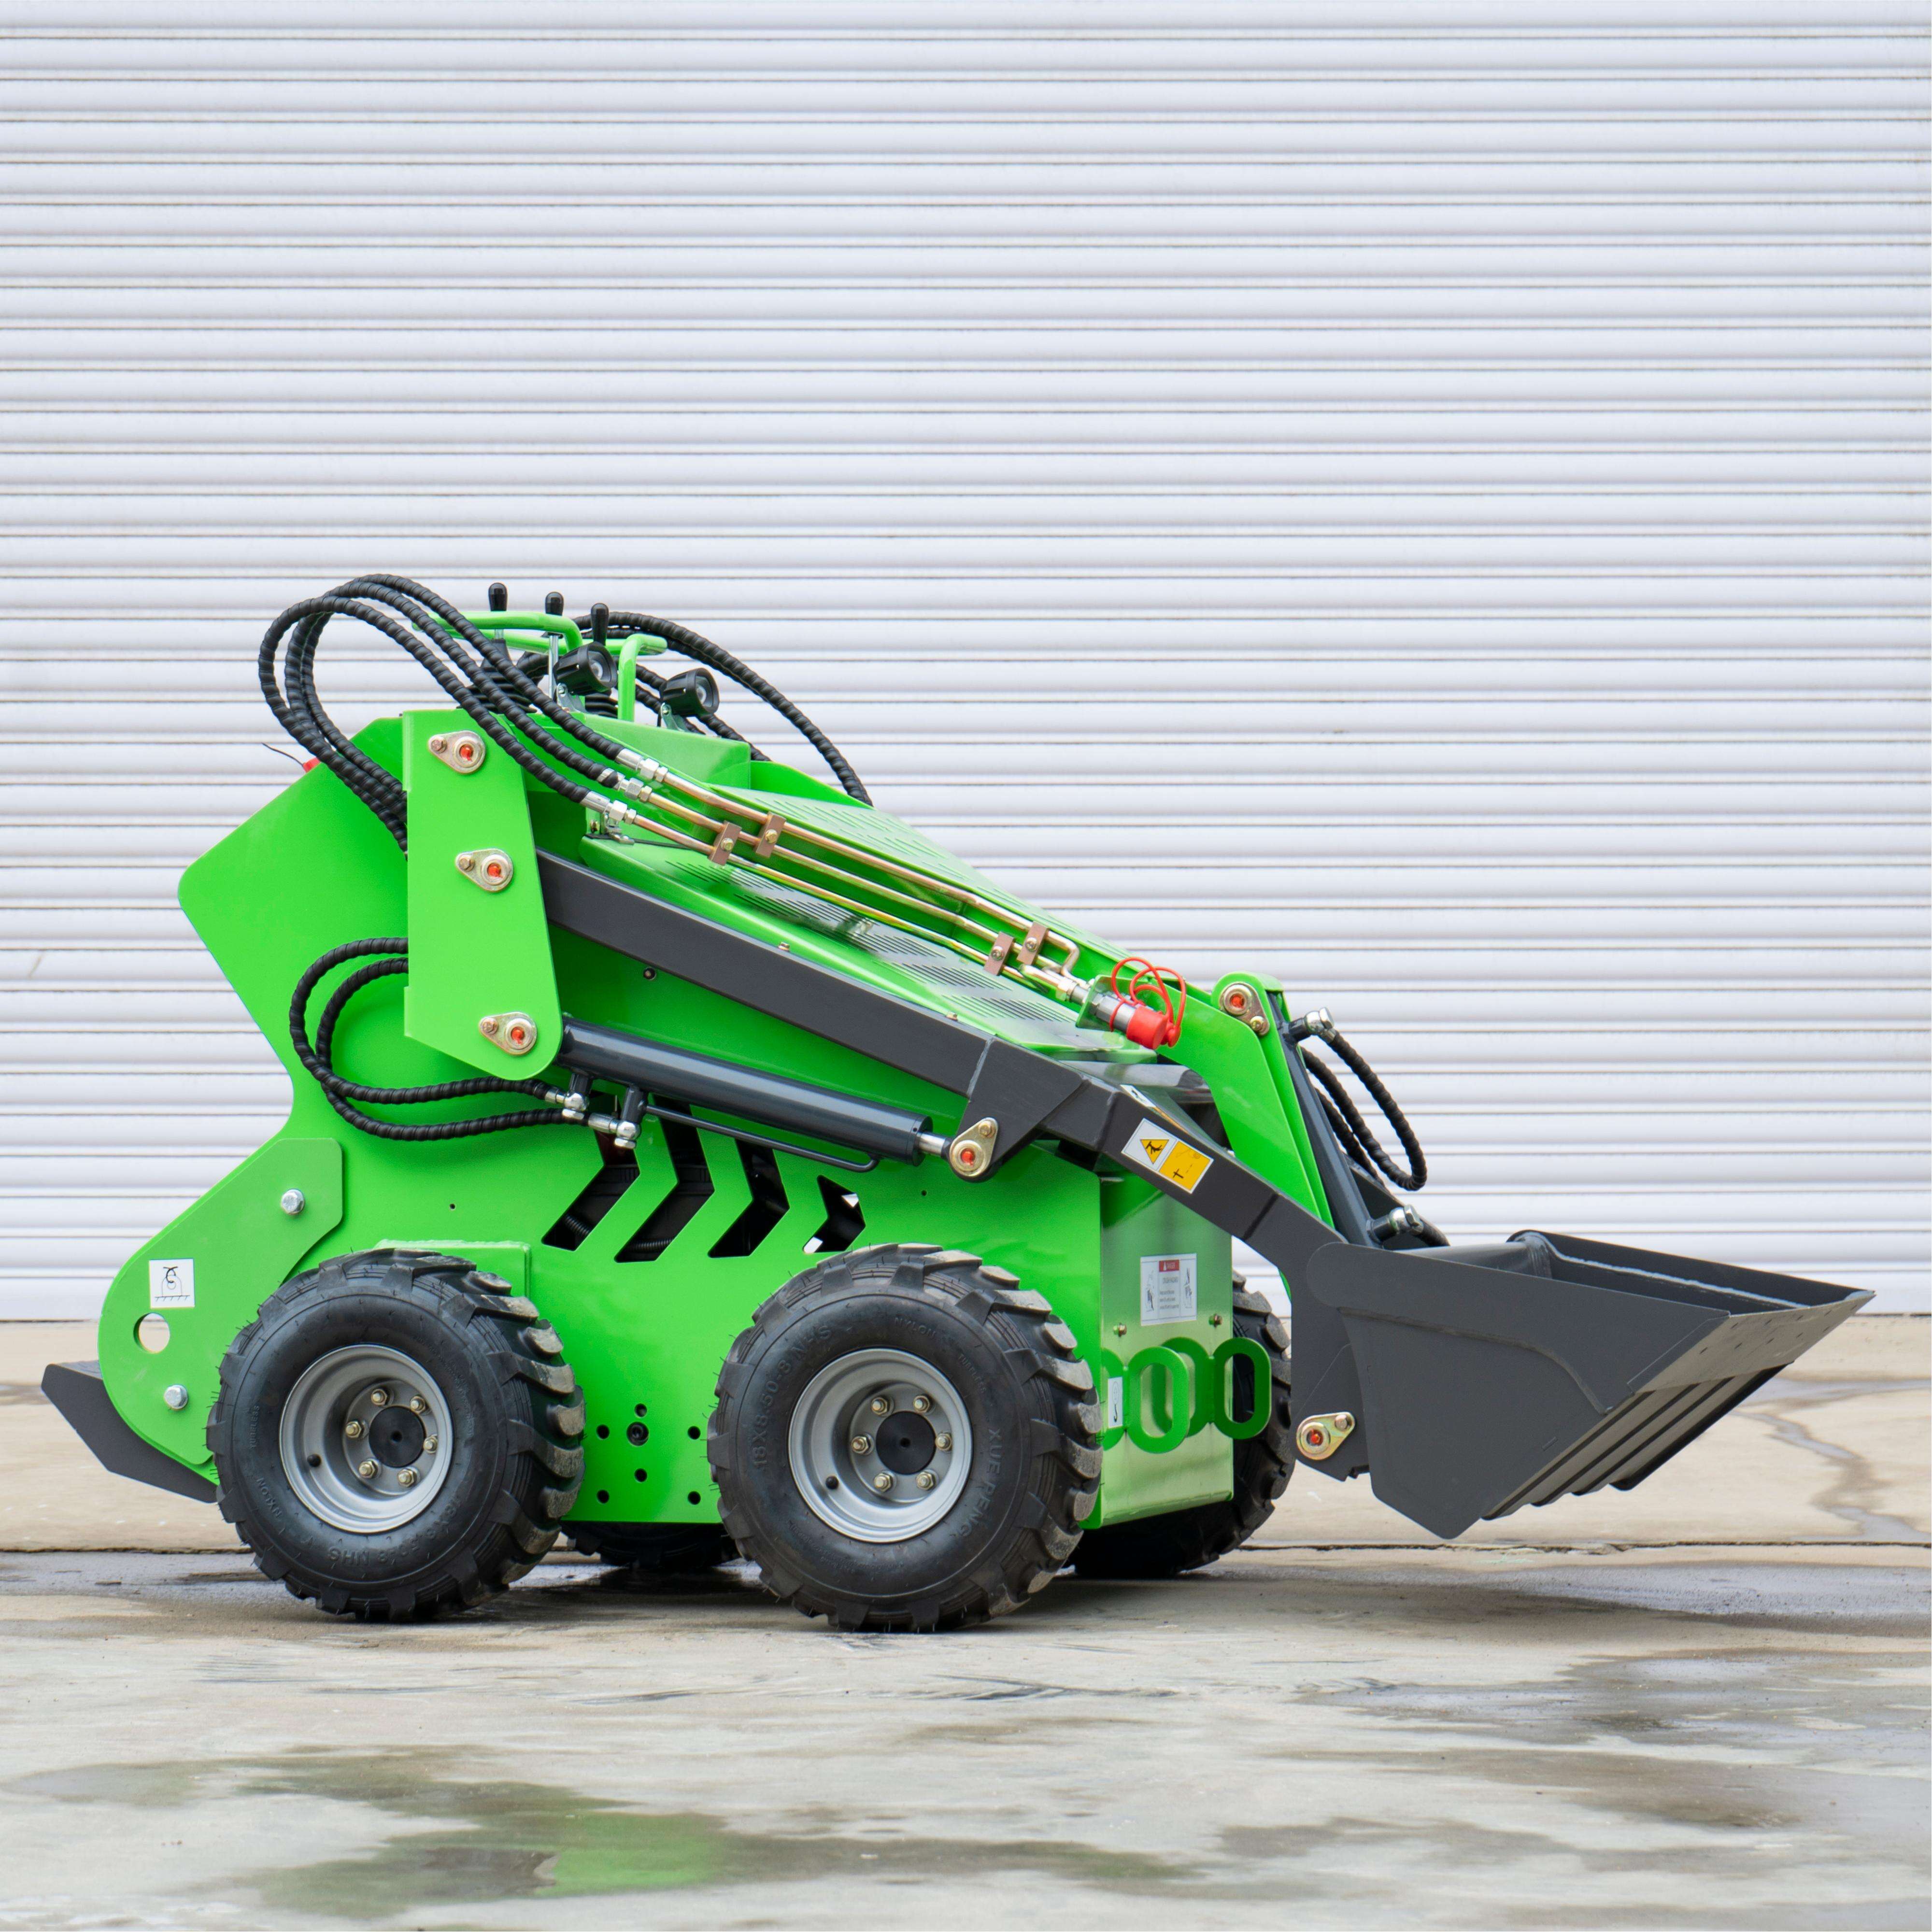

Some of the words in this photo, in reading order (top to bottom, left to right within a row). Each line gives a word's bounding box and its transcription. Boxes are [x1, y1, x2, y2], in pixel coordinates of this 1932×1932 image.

[895, 1317, 937, 1337] NYLON
[249, 1405, 260, 1449] TUBELESS
[753, 1359, 792, 1466] 18X8.50-8
[988, 1428, 1003, 1475] XUE
[256, 1477, 283, 1519] NYLON
[957, 1479, 997, 1537] PENG
[328, 1547, 369, 1566] NHS
